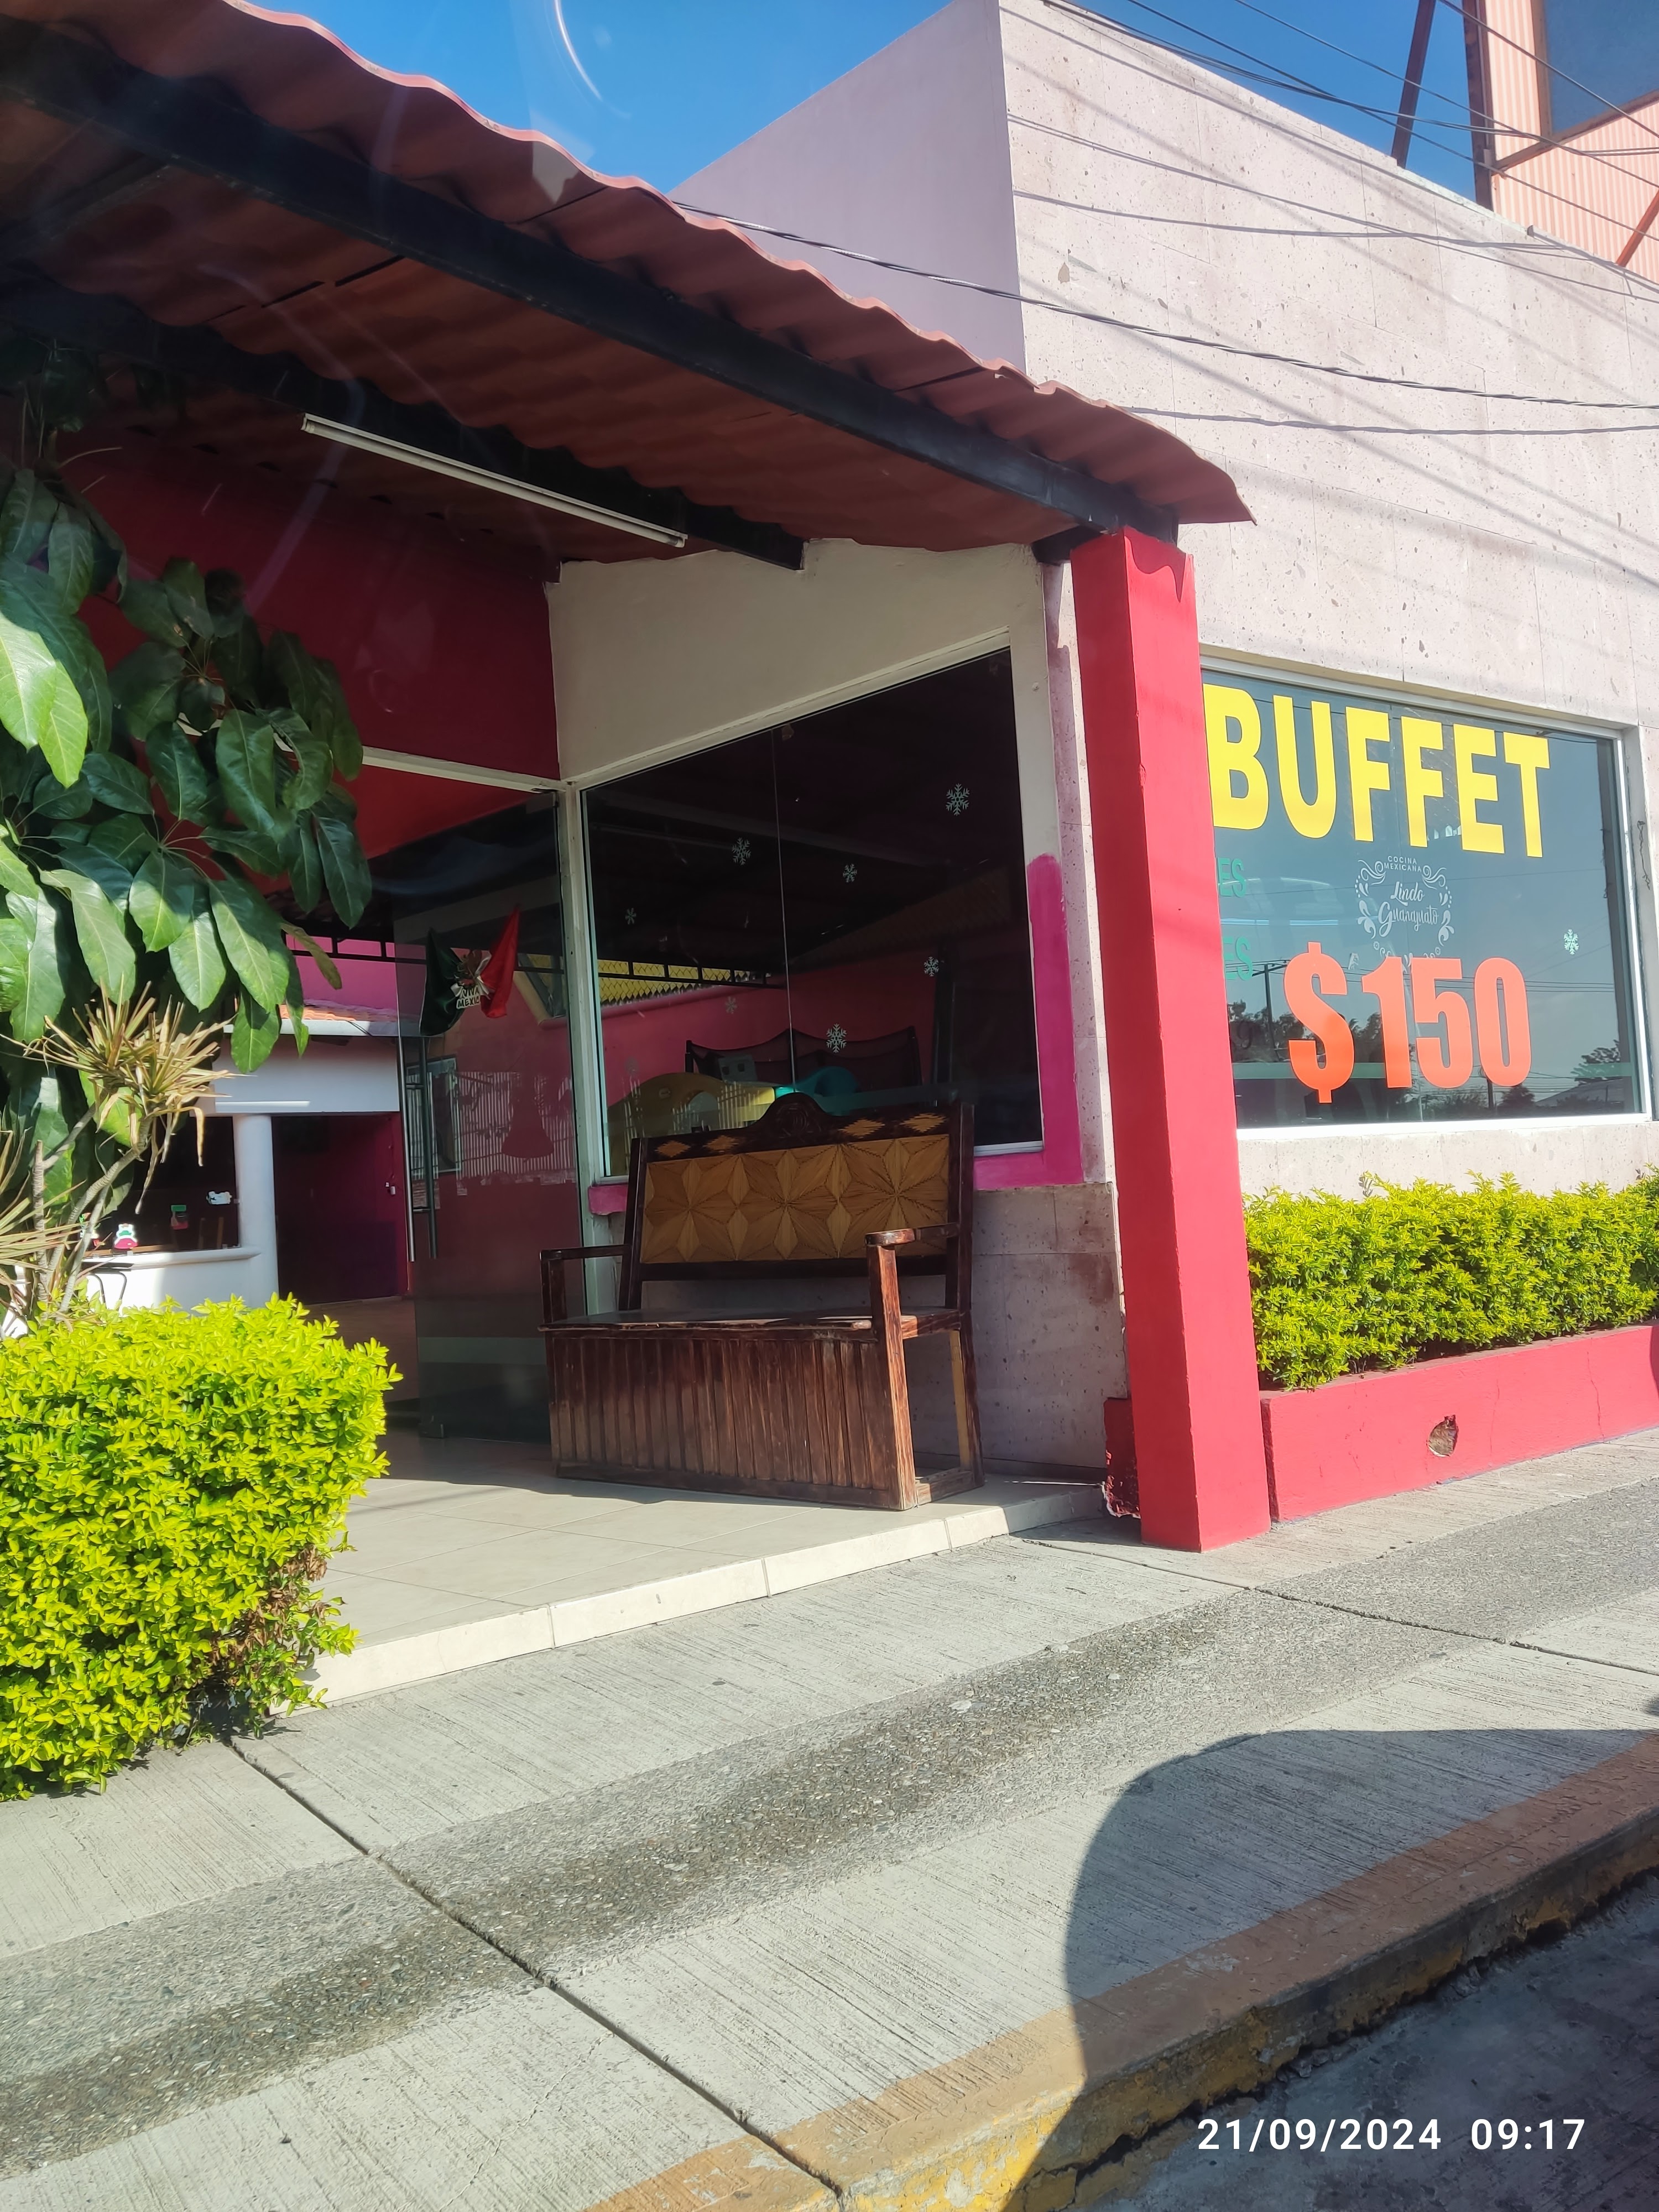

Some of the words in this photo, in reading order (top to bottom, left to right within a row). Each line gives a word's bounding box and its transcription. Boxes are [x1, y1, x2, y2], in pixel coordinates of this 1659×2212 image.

[1203, 684, 1550, 858] BUFFET
[1384, 862, 1422, 873] MEXICANA
[1387, 855, 1417, 865] COCINA
[1390, 881, 1425, 906] Lindo
[1378, 901, 1439, 937] Guanajuato
